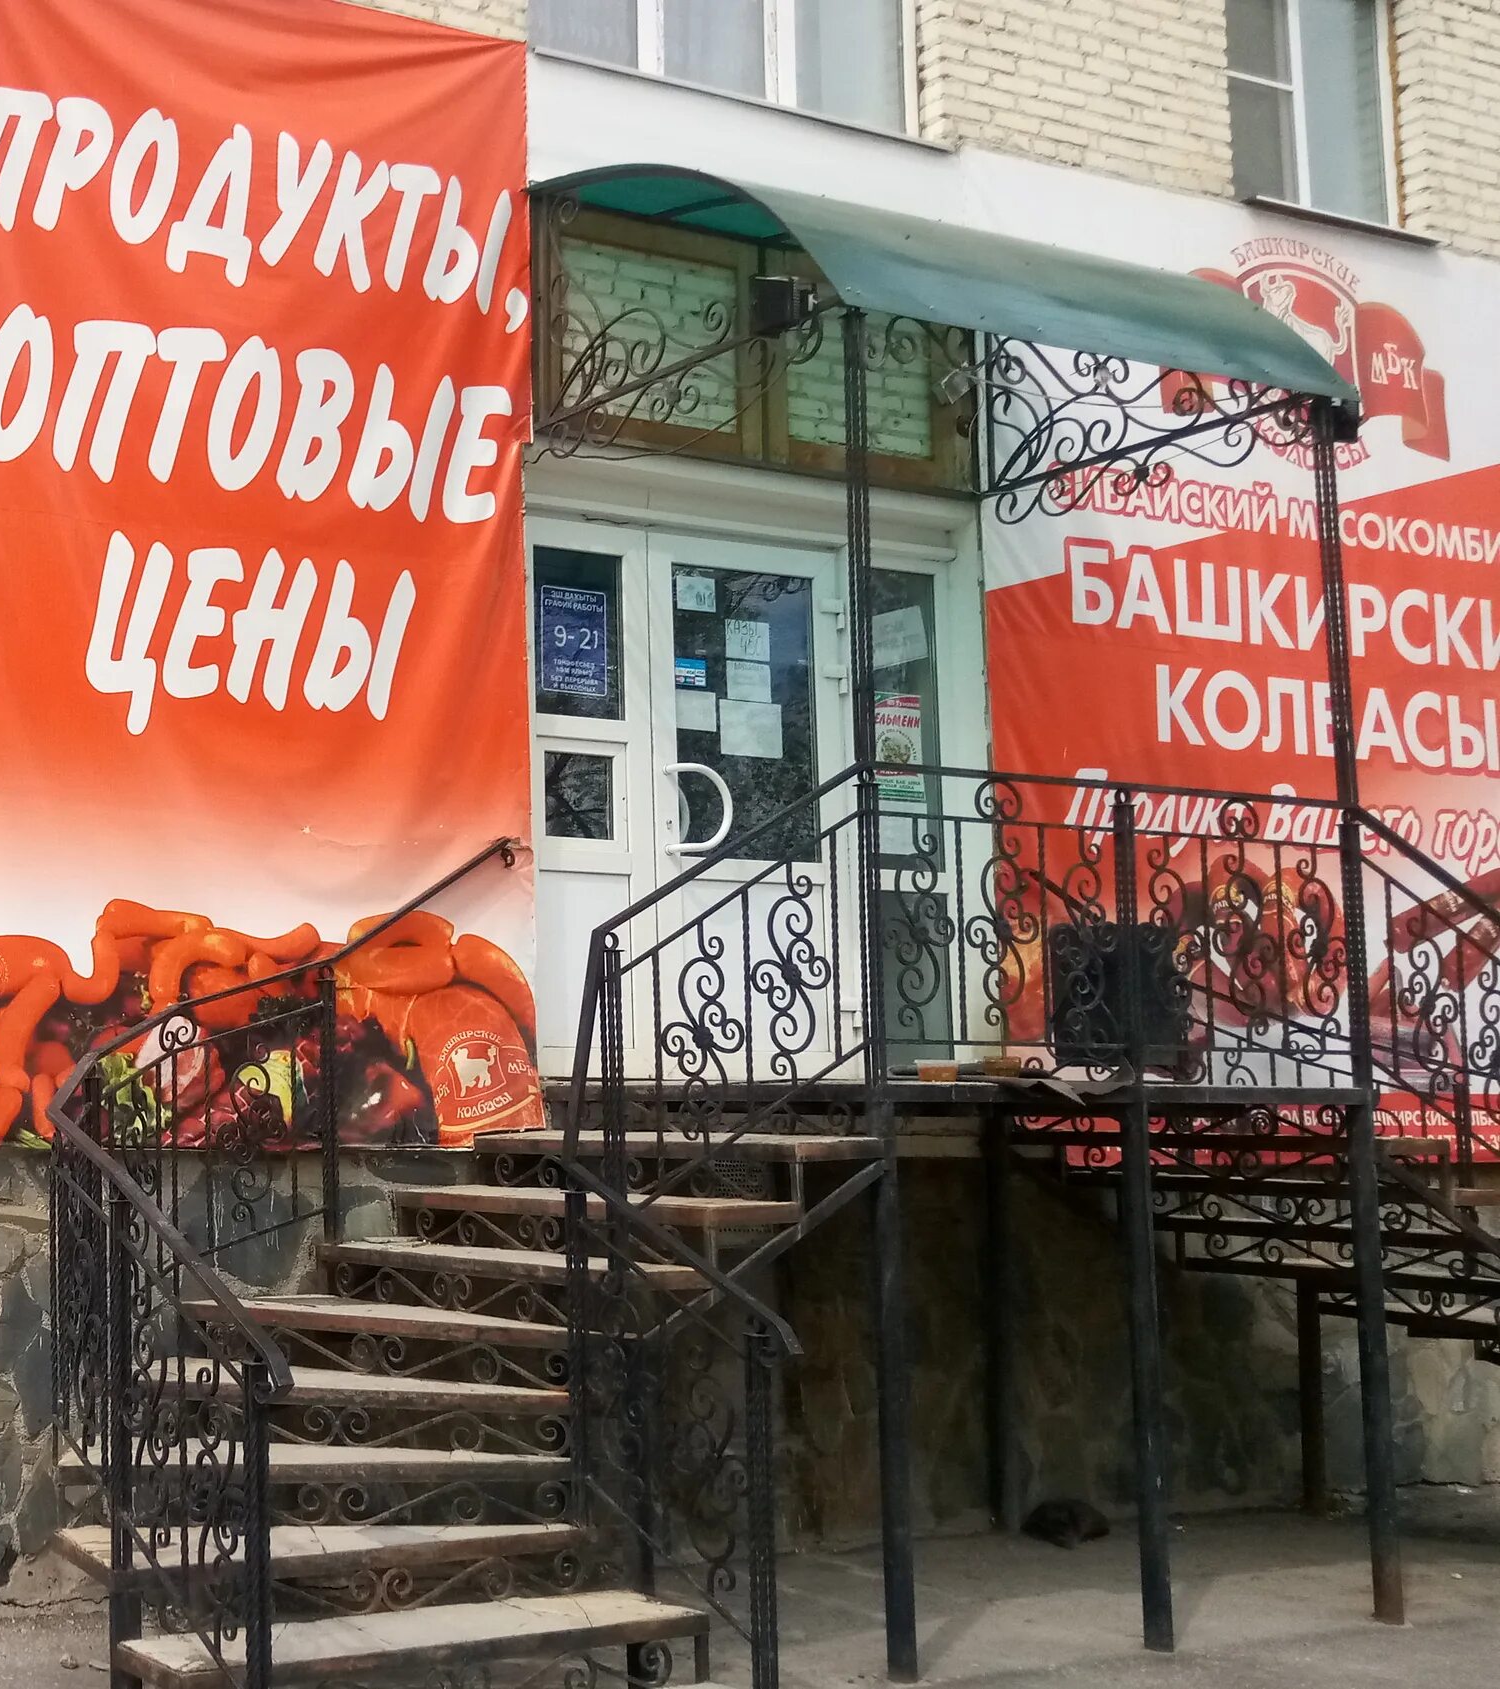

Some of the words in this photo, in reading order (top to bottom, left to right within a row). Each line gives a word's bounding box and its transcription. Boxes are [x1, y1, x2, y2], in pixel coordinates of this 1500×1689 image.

[1230, 236, 1361, 294] БАШКИРСКИЕ
[1288, 500, 1500, 565] МСОКОМБИ
[85, 529, 417, 736] ЦЕНЫ
[572, 602, 604, 613] РАБОТЫ
[1069, 543, 1500, 672] БАШКИРСКИ
[874, 711, 921, 729] ЕЛЬМЕНИ
[1433, 811, 1500, 877] гор
